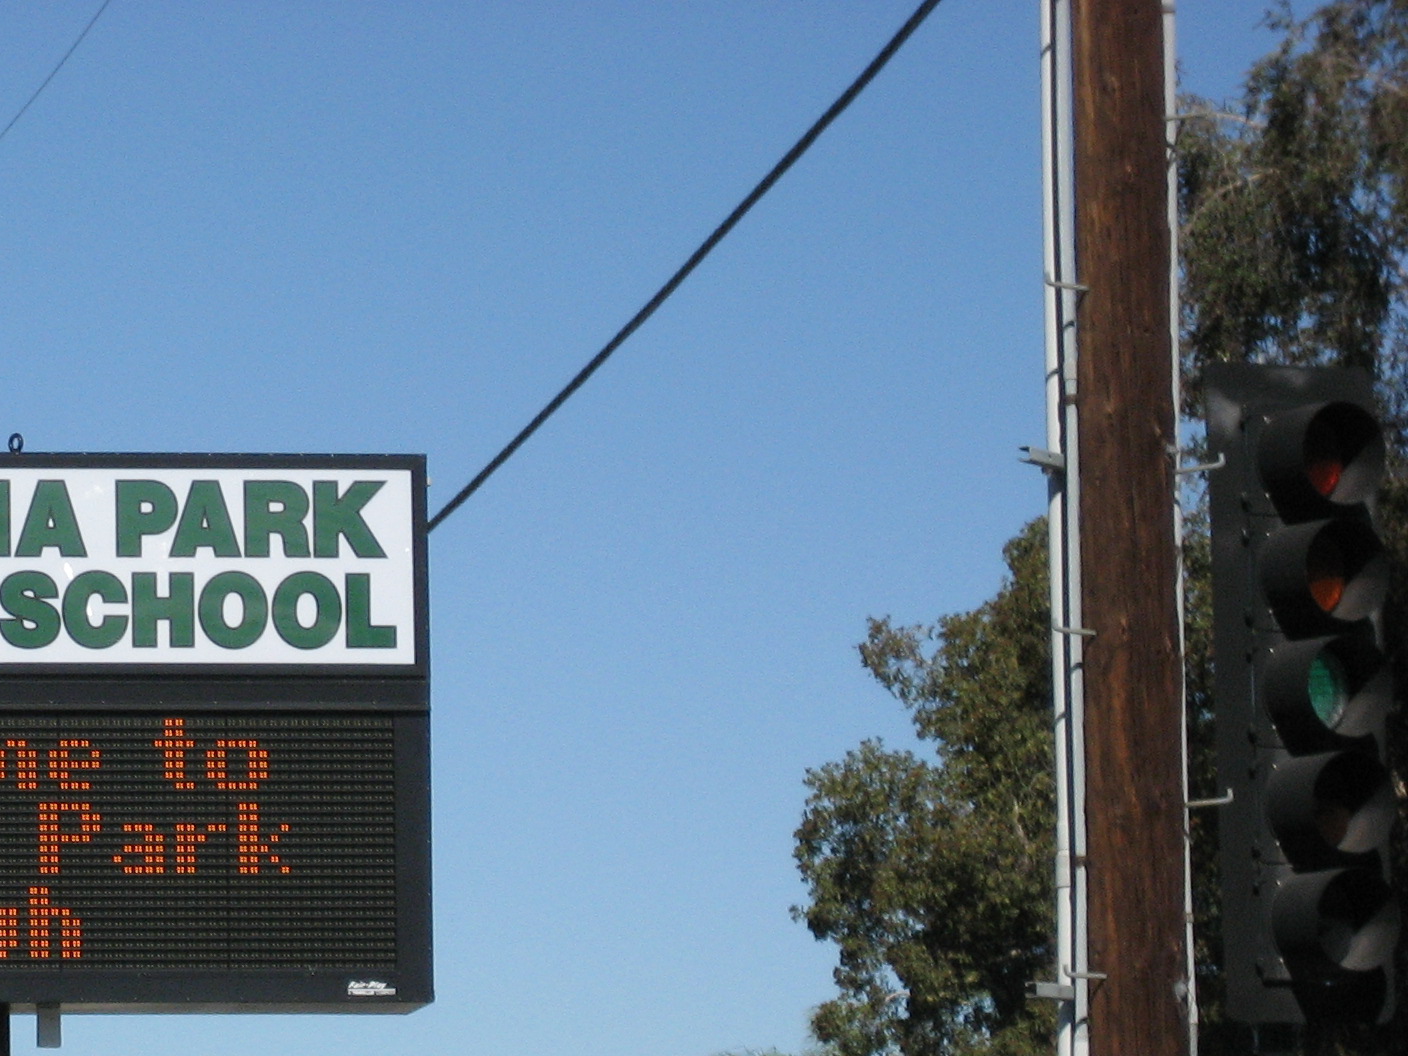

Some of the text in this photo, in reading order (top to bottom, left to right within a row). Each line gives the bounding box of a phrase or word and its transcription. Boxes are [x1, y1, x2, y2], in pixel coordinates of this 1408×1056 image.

[115, 479, 388, 559] PARK
[154, 718, 269, 790] to
[38, 802, 290, 874] Park
